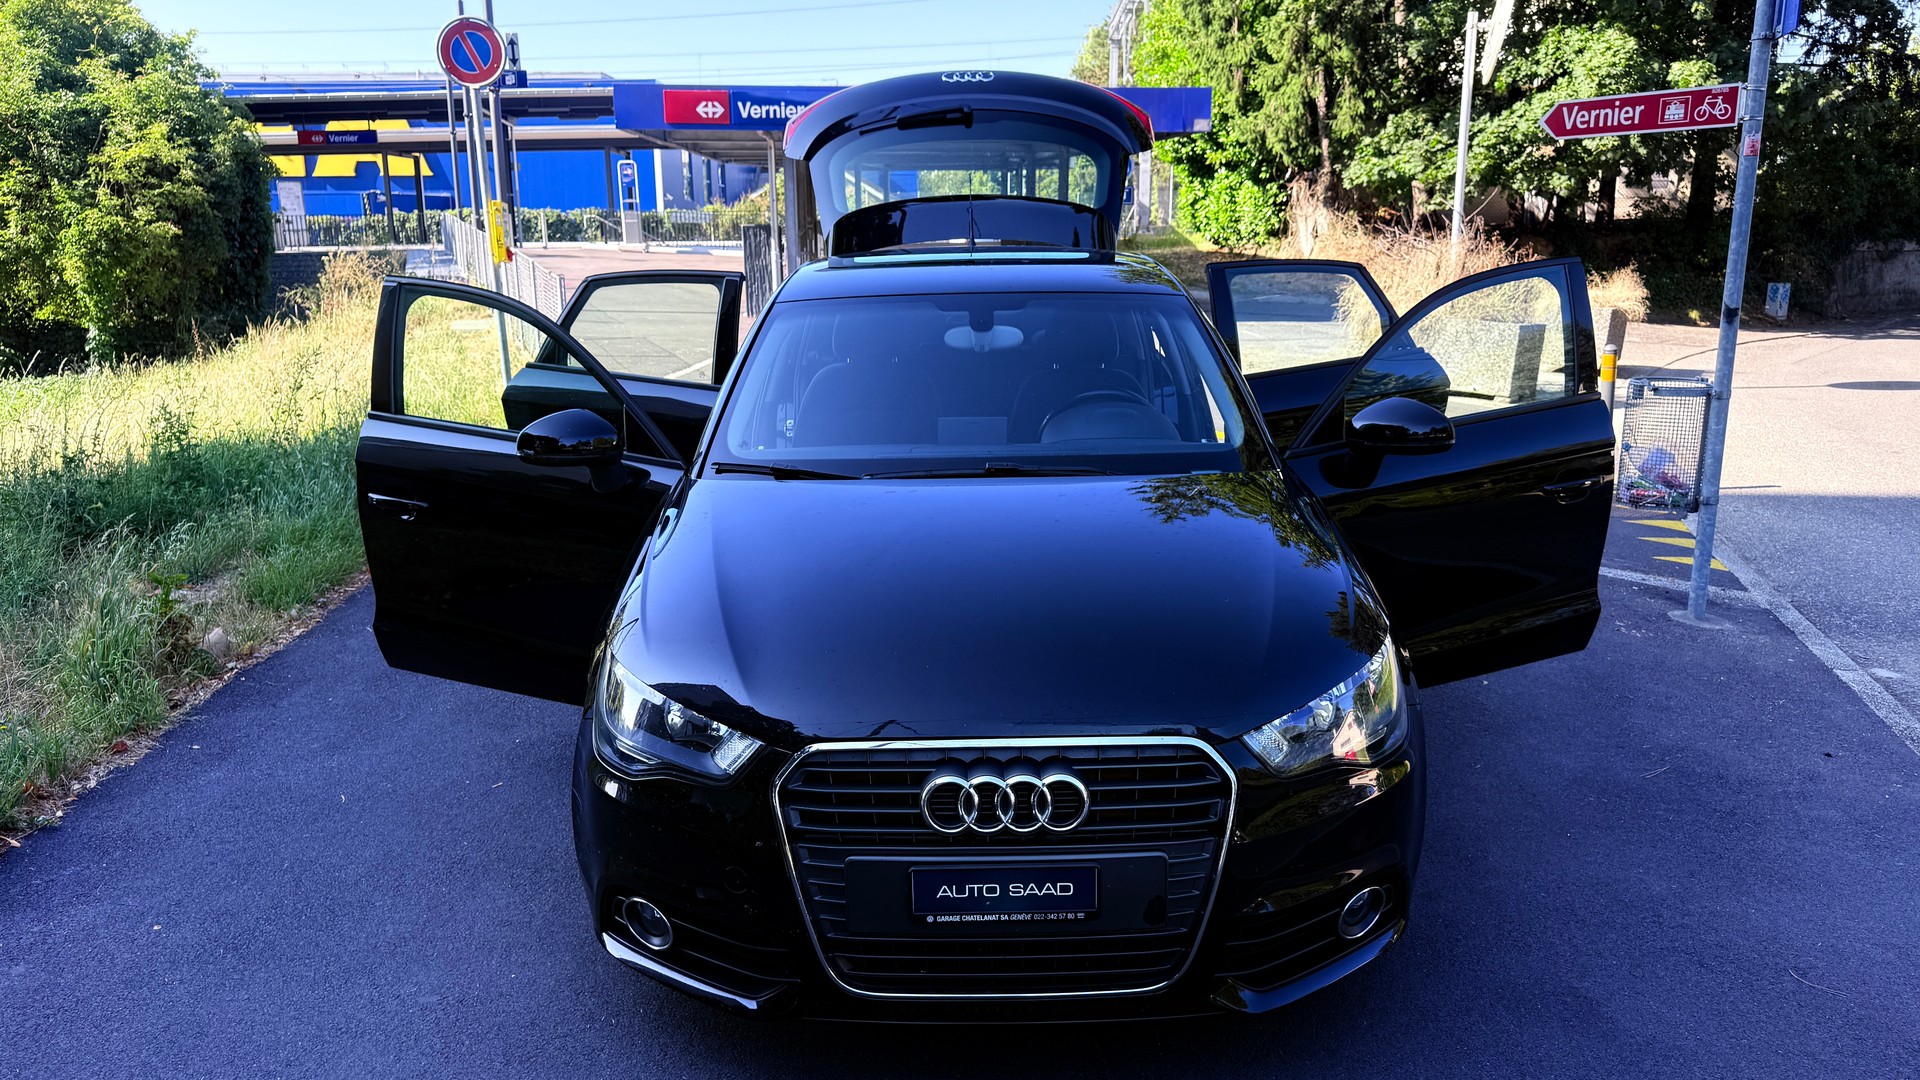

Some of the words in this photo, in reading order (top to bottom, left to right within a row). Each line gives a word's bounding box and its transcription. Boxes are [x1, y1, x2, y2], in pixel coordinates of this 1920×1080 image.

[737, 101, 806, 119] Vernier
[1562, 100, 1645, 130] Vernier
[329, 134, 359, 142] Vernier
[936, 884, 1000, 899] AUTO
[1008, 882, 1074, 897] SAAD
[961, 914, 999, 922] CHATELANAT
[1058, 912, 1066, 920] 57
